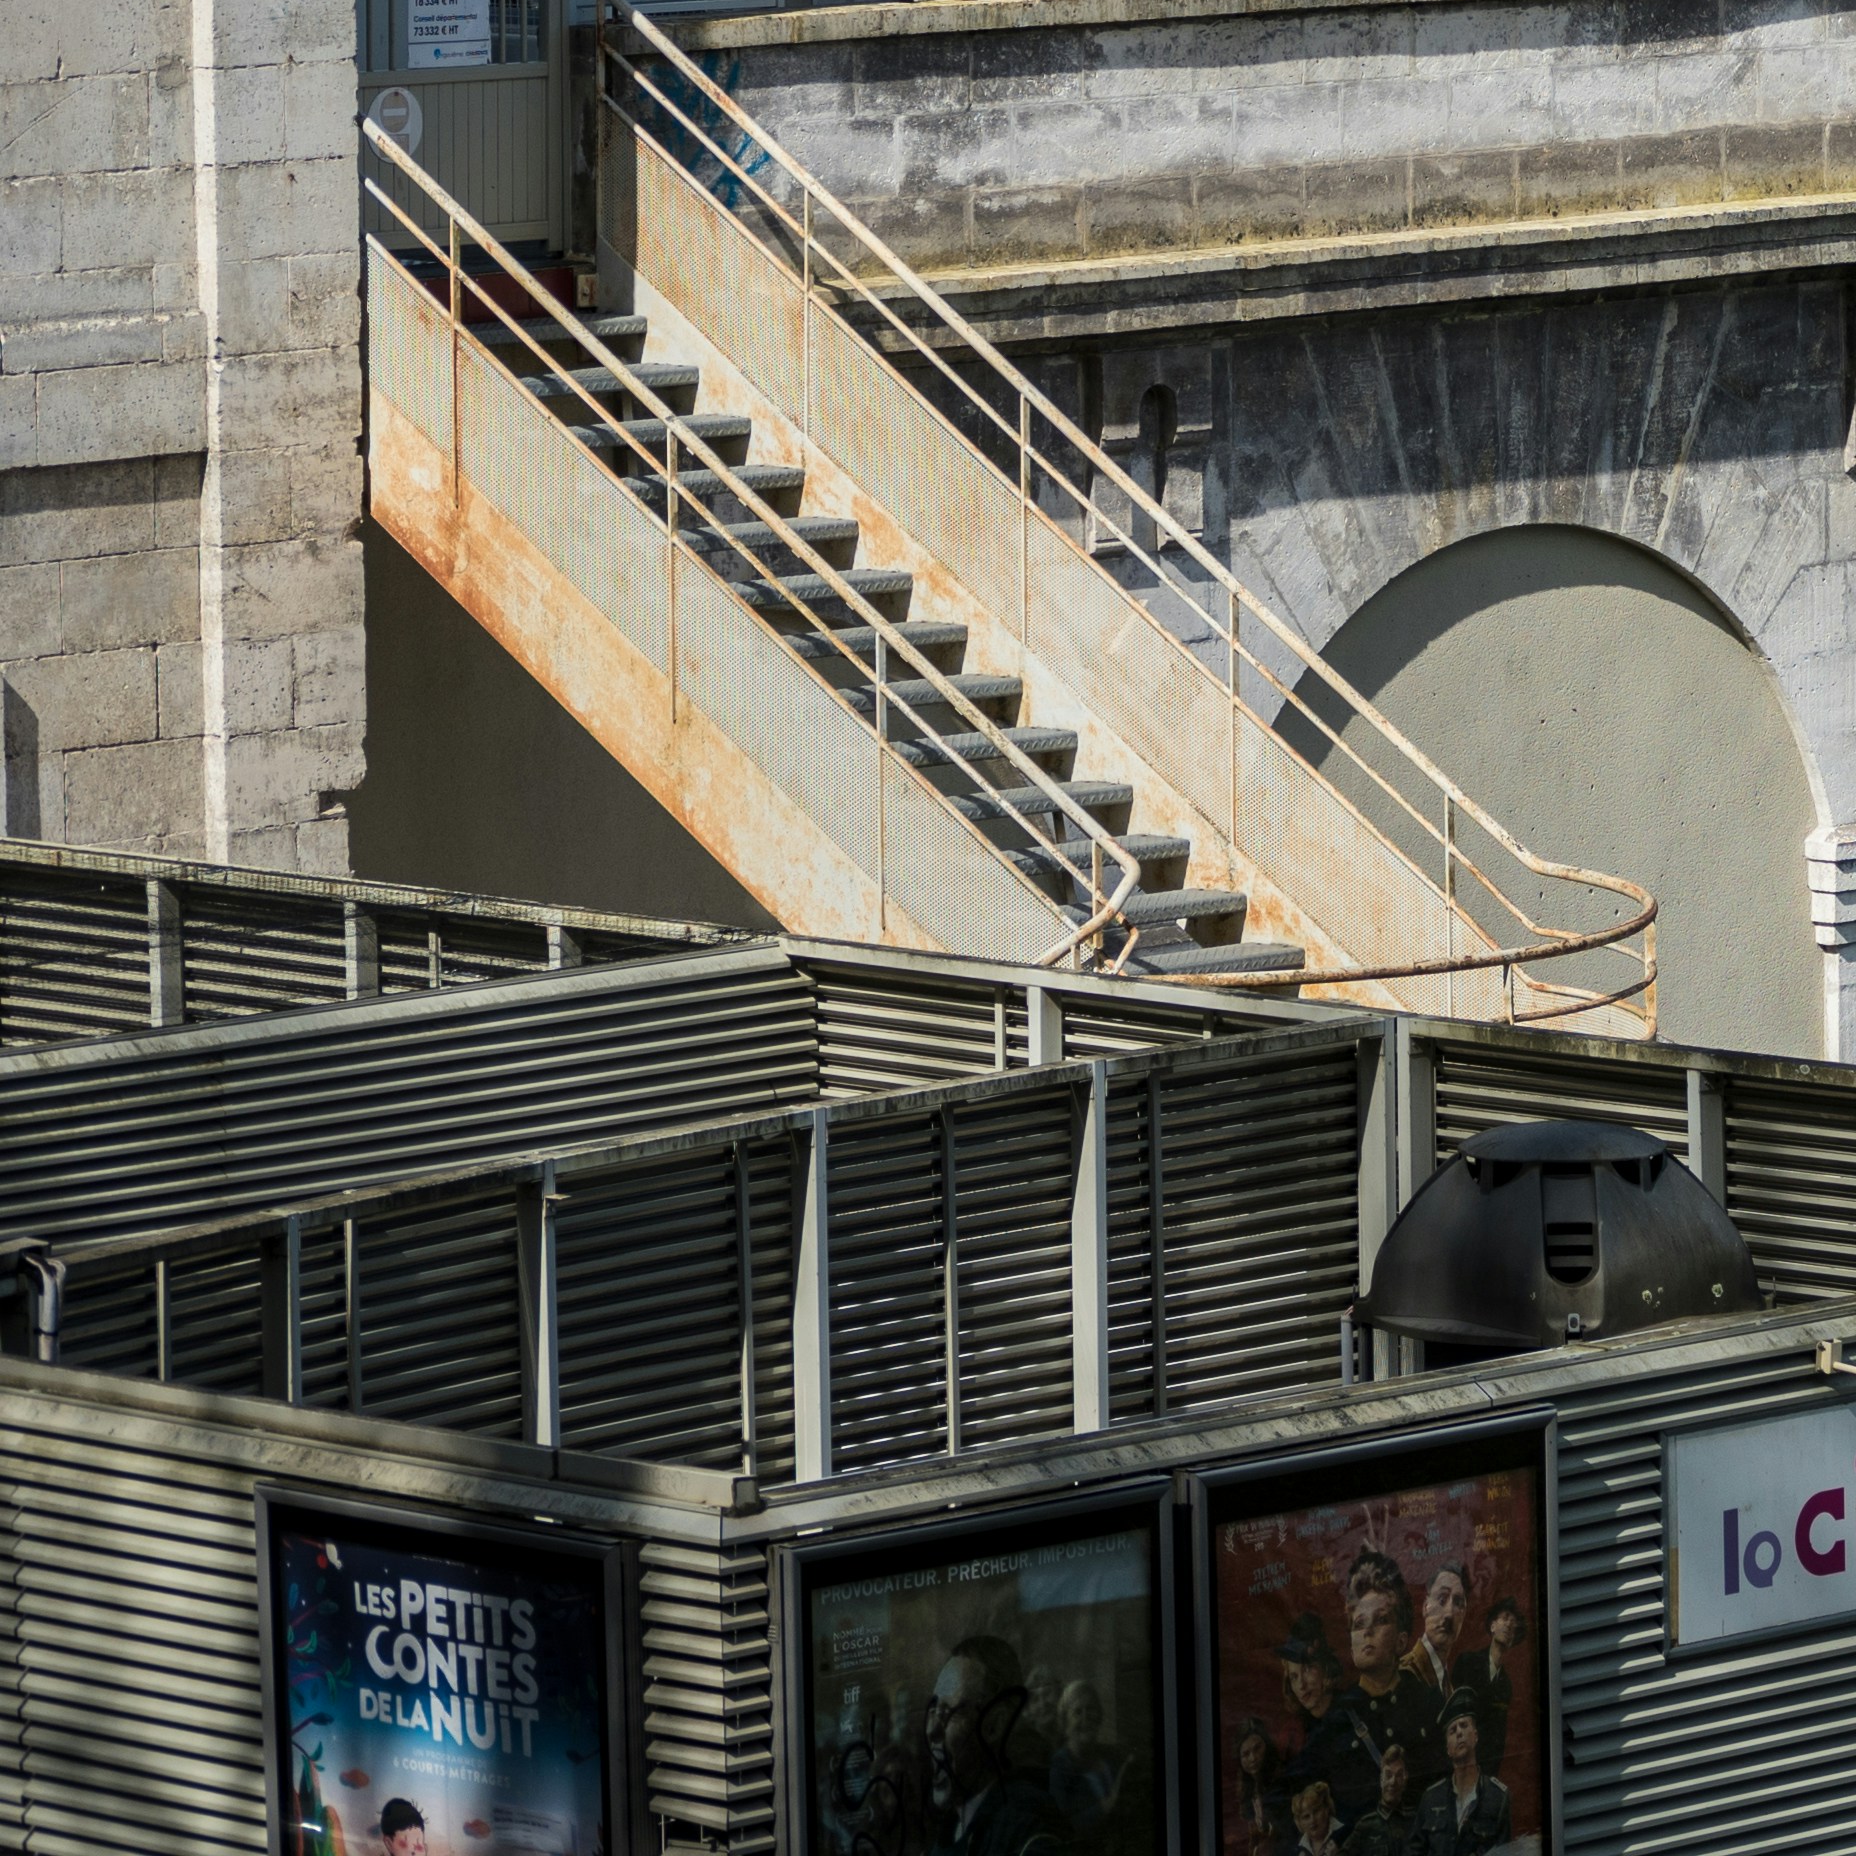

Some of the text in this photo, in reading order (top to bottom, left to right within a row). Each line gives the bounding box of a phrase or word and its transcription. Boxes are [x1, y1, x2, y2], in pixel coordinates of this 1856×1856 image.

[448, 25, 459, 35] HT
[820, 1534, 1133, 1605] PROVOCATEUR. PRÊCHEUR. IMPOSTEUR.
[353, 1580, 396, 1620] LES
[833, 1634, 881, 1654] L'OSCAR
[365, 1624, 540, 1705] CONTES
[358, 1686, 393, 1725] DE
[395, 1694, 430, 1732] LA
[393, 1757, 512, 1788] 6 COURTS MÉTRAGES
